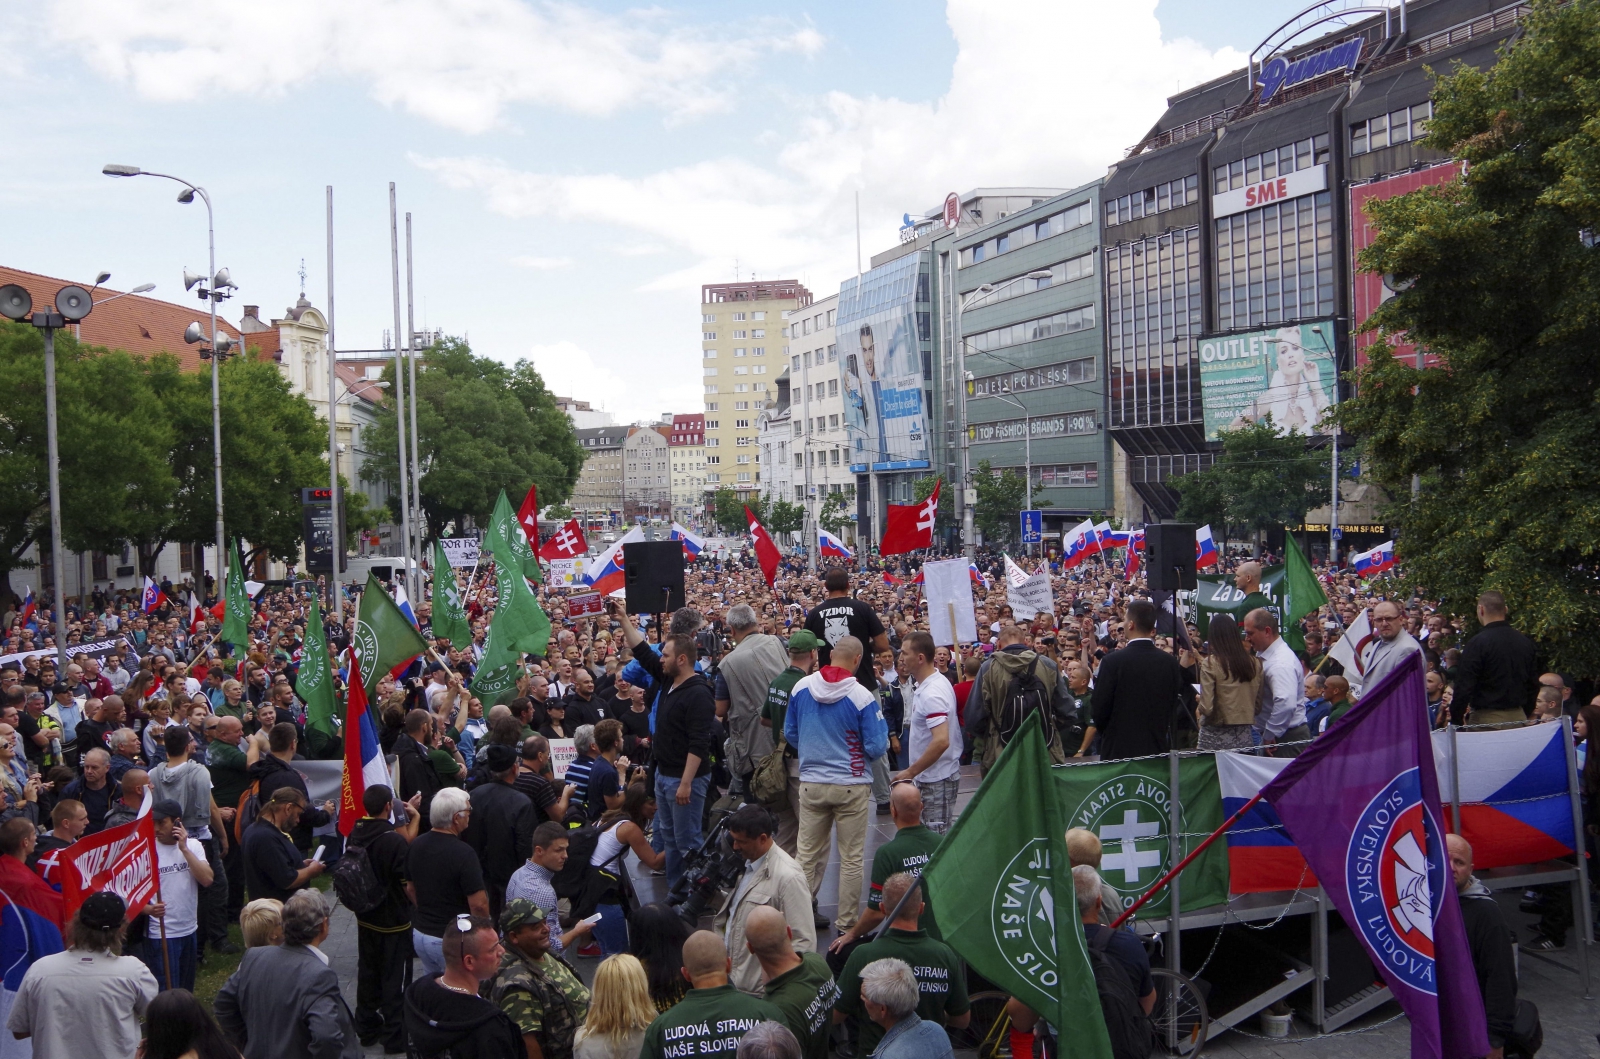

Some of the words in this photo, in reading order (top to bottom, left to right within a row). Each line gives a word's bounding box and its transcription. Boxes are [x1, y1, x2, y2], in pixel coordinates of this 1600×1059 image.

[1245, 177, 1287, 208] SME
[1201, 335, 1270, 363] OUTLET
[1014, 374, 1036, 389] FOR
[1041, 368, 1067, 387] LESS
[980, 427, 994, 440] TOP
[995, 423, 1029, 438] FASHION
[1031, 418, 1065, 434] BRANDS
[1360, 525, 1385, 534] SPACE
[1211, 580, 1233, 602] Za
[818, 606, 855, 619] VZDOR
[1356, 789, 1404, 904] SLOVENSKÁ
[902, 852, 929, 867] ĽUDOVÁ
[1001, 874, 1031, 939] NAŠE
[1367, 914, 1433, 983] ĽUDOVÁ
[913, 965, 949, 979] STRANA
[664, 1020, 711, 1041] ĽUDOVÁ
[663, 1041, 695, 1059] NAŠE
